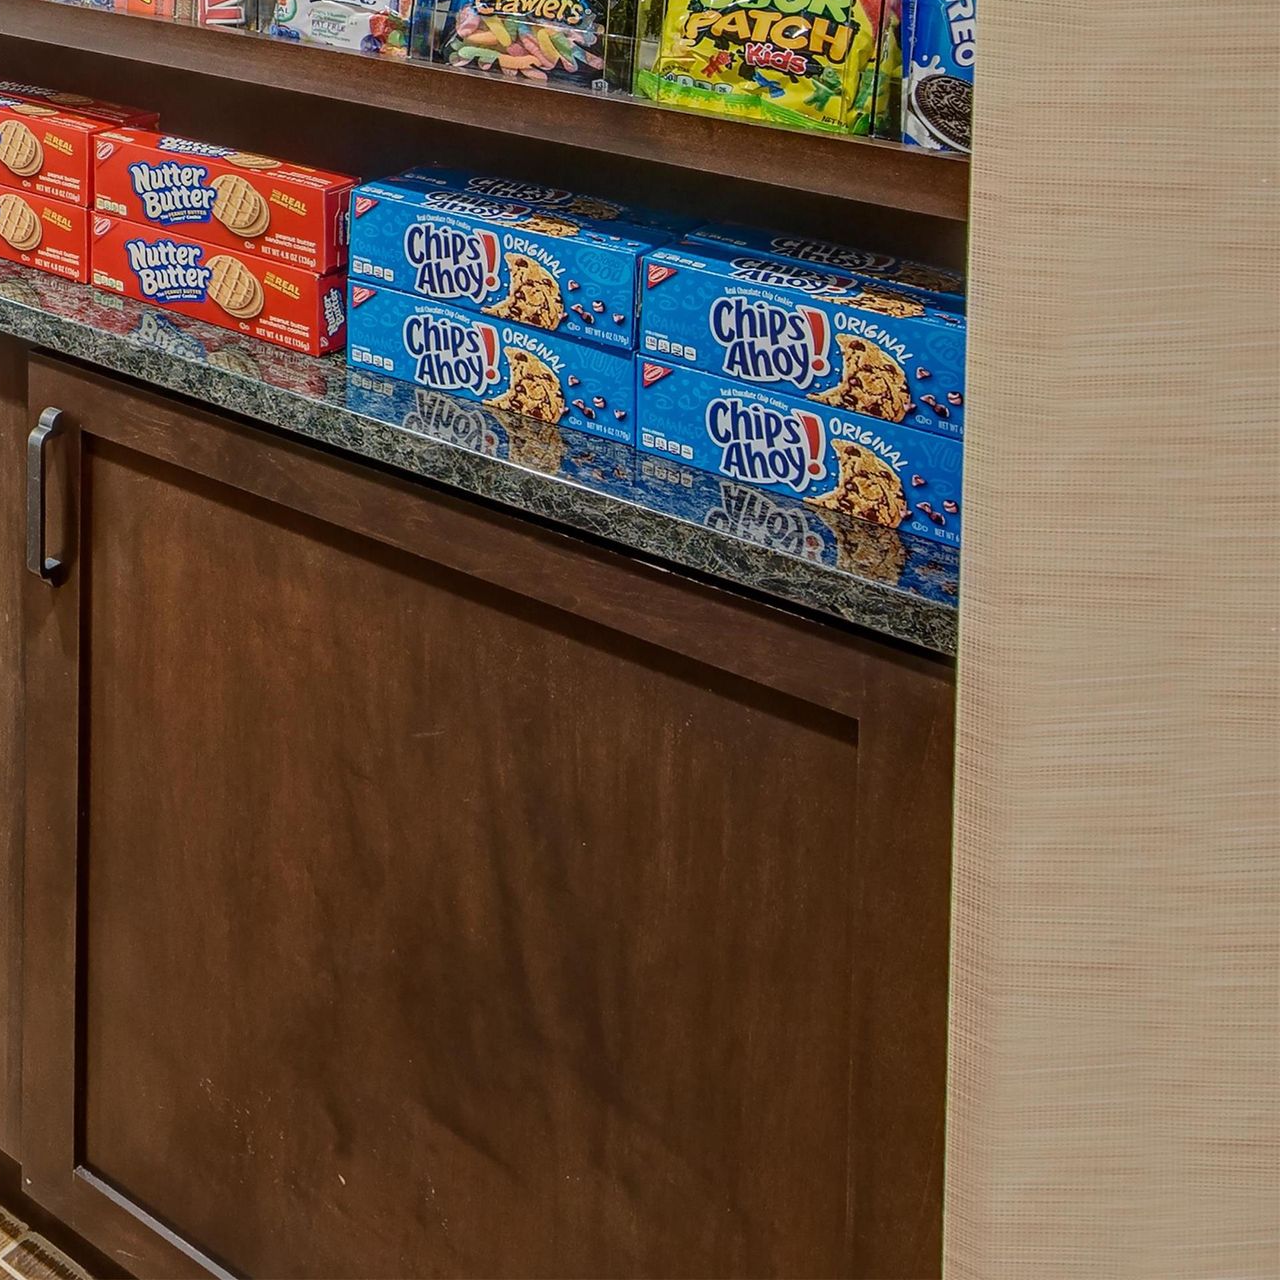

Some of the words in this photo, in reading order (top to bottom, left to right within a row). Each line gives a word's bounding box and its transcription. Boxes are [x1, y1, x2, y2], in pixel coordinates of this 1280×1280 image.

[686, 10, 854, 62] PATCH
[746, 43, 807, 74] Kids
[51, 135, 73, 152] REAL
[131, 162, 205, 195] Nutter
[142, 186, 216, 219] Butter
[280, 194, 307, 212] REAL
[50, 211, 72, 228] REAL
[265, 236, 291, 249] sandwich
[293, 243, 316, 254] cookies
[297, 237, 316, 247] butter
[408, 226, 481, 265] Chips
[128, 241, 201, 274] Nutter
[290, 252, 297, 261] OZ
[503, 233, 566, 279] ORIGINAL
[139, 265, 210, 297] Butter
[274, 277, 301, 296] REAL
[259, 318, 286, 331] sandwich
[287, 326, 310, 338] cookies
[290, 320, 310, 330] butter
[584, 327, 593, 335] NET
[713, 299, 805, 345] Chips
[284, 335, 292, 344] OZ
[407, 318, 481, 357] Chips
[834, 312, 913, 365] ORIGINAL
[503, 328, 566, 373] ORIGINAL
[586, 421, 595, 429] NET
[708, 402, 800, 447] Chips
[938, 420, 948, 429] NET
[829, 417, 909, 470] ORIGINAL
[934, 527, 944, 535] NET
